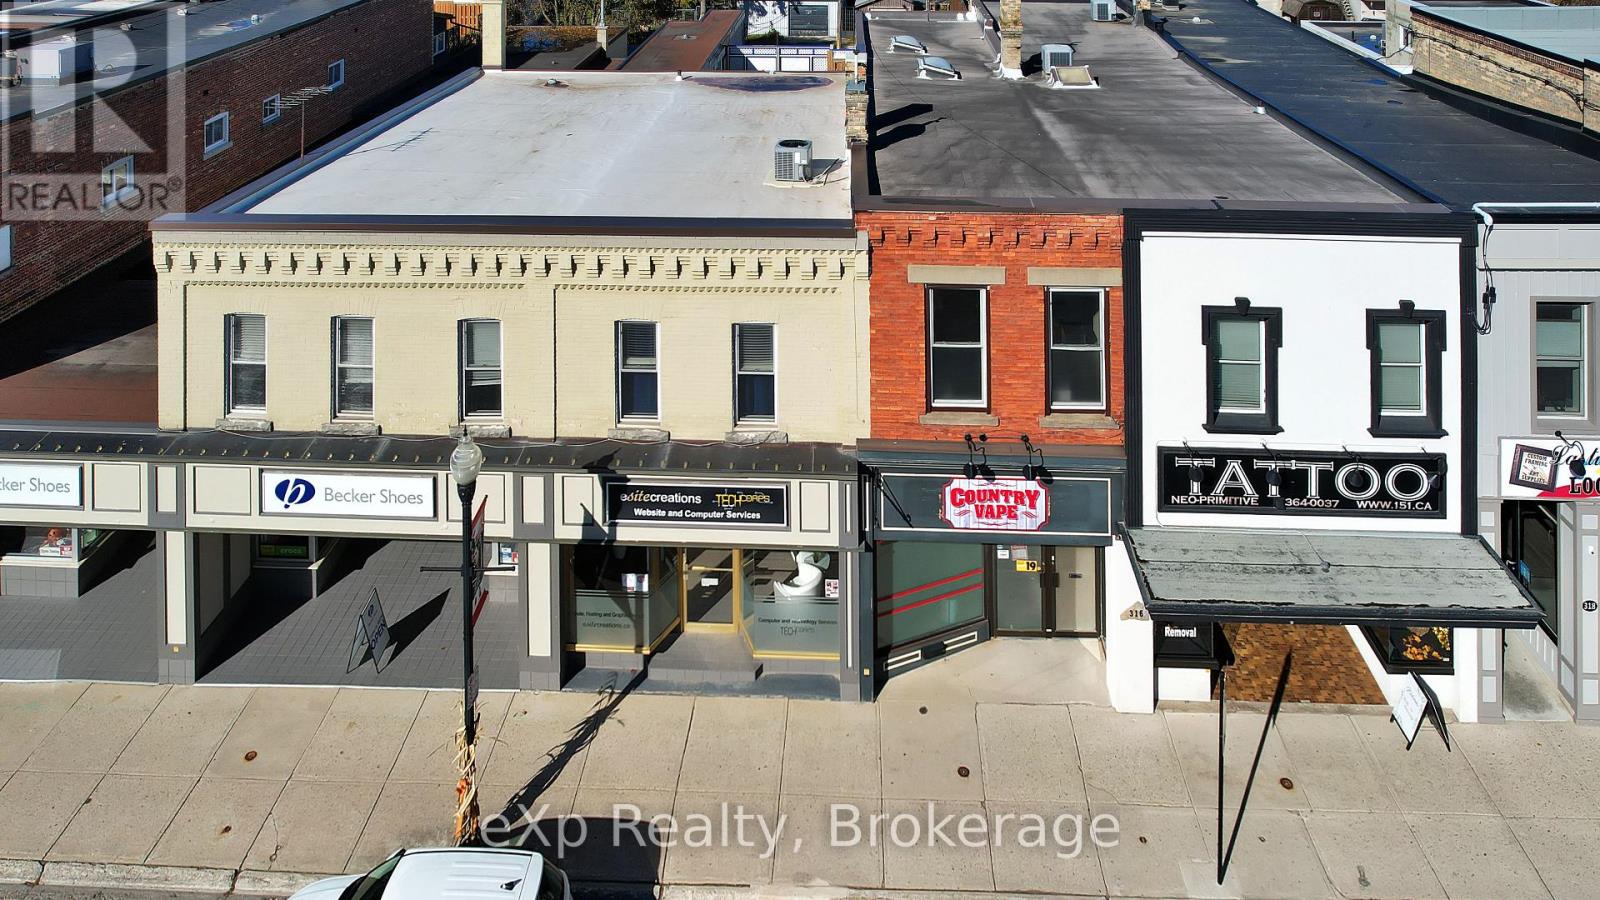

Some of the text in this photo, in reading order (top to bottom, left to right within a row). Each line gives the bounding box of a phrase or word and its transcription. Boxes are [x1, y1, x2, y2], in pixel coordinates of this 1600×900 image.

[29, 477, 71, 493] Shoes
[1175, 456, 1431, 501] TATTOO
[324, 487, 424, 505] Becker Shoes
[620, 490, 702, 504] esitecreations
[1171, 495, 1433, 511] NEO-PRIMITIVE 364-0037 WWW.151.CA
[633, 508, 761, 520] Website and Computer Services
[974, 504, 1018, 520] VAPE
[1026, 561, 1037, 571] 19
[1129, 609, 1144, 618] 316
[371, 622, 386, 649] OPEN
[1164, 626, 1197, 638] Removal
